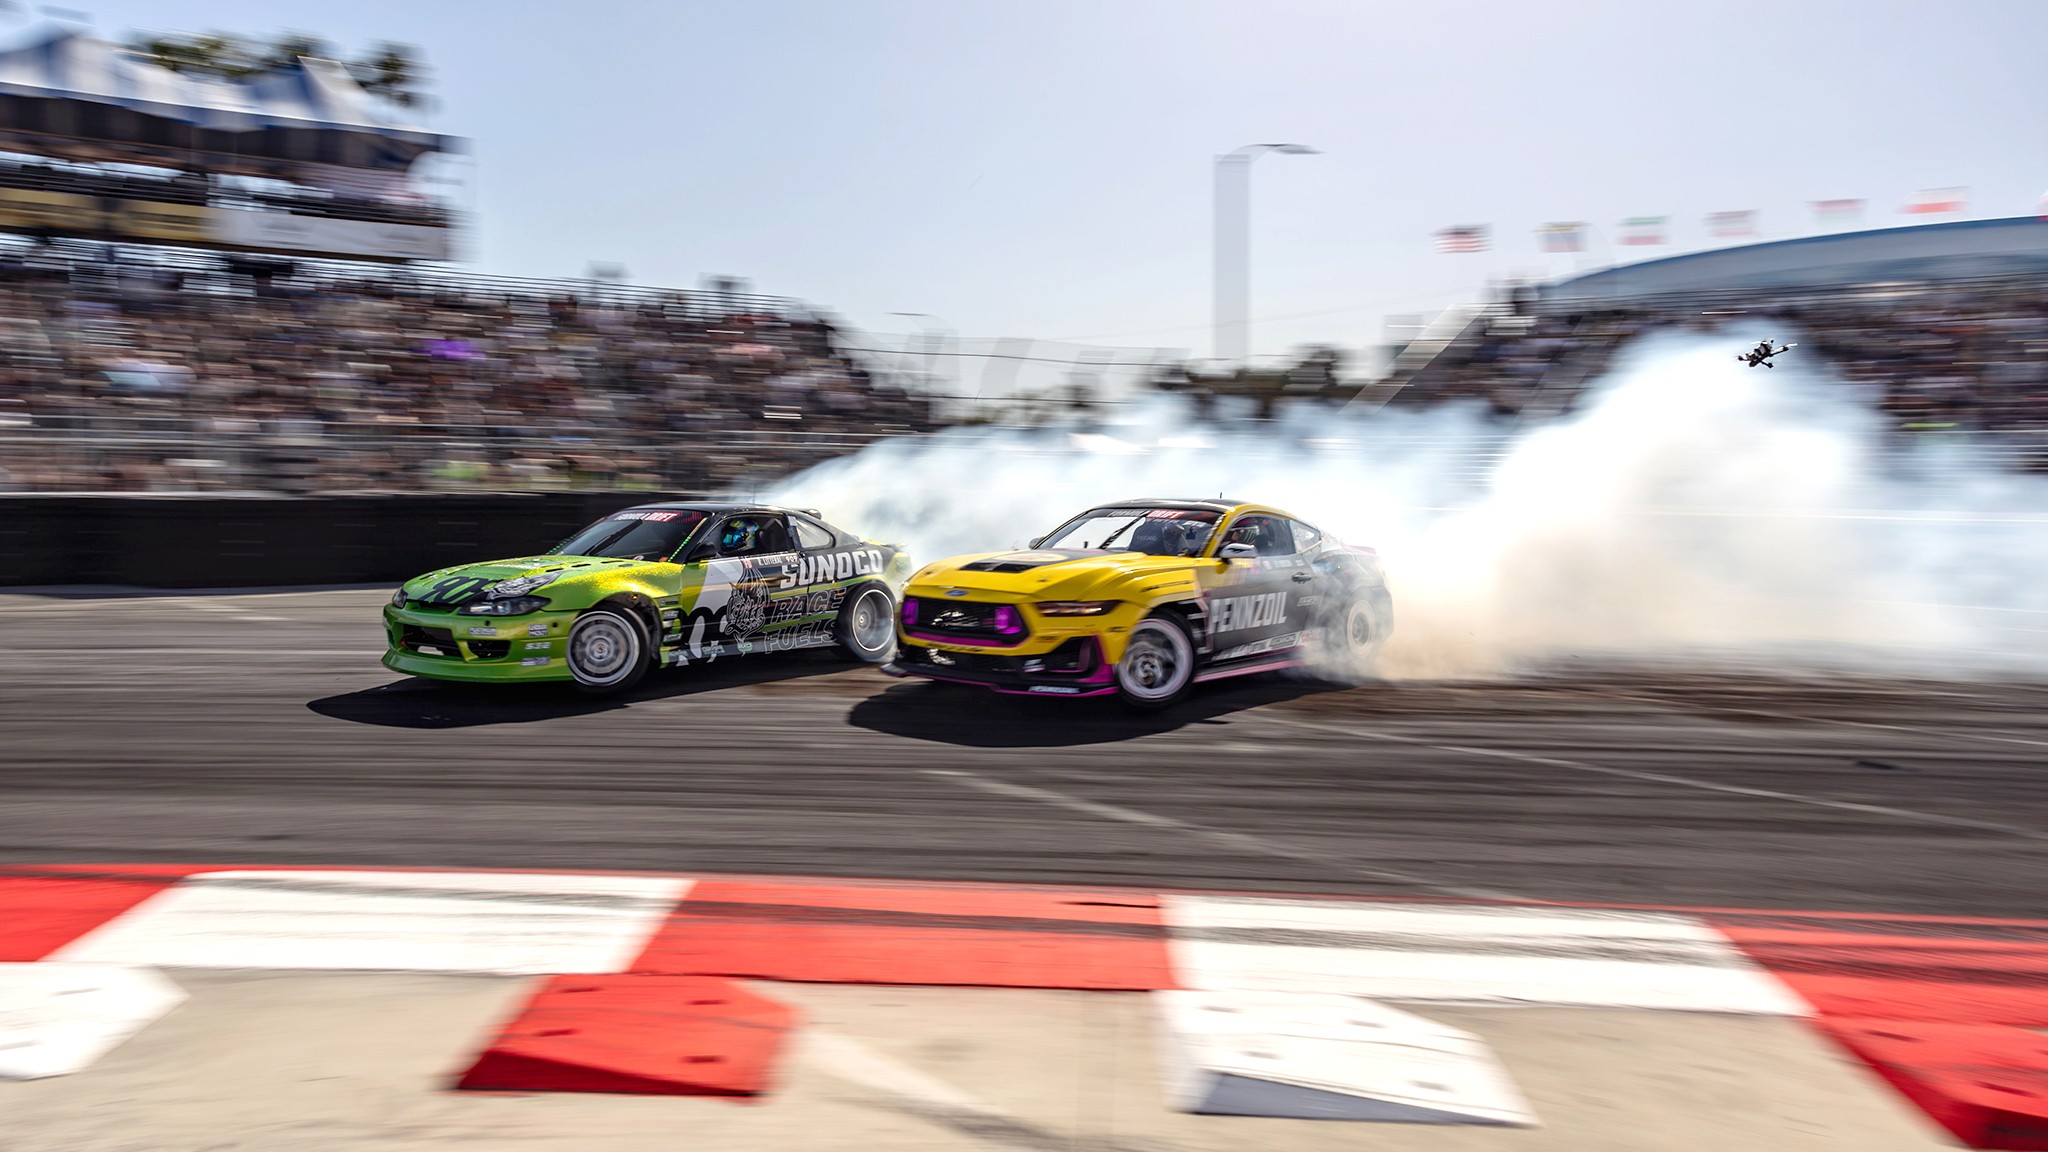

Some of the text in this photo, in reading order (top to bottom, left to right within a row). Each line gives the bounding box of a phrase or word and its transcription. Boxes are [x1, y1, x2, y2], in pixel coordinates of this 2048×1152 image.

[644, 512, 678, 522] DRIFT
[780, 549, 883, 589] SUNOCO
[770, 587, 847, 624] RACE
[1208, 591, 1288, 634] PENNZOIL
[763, 619, 837, 654] FUELS
